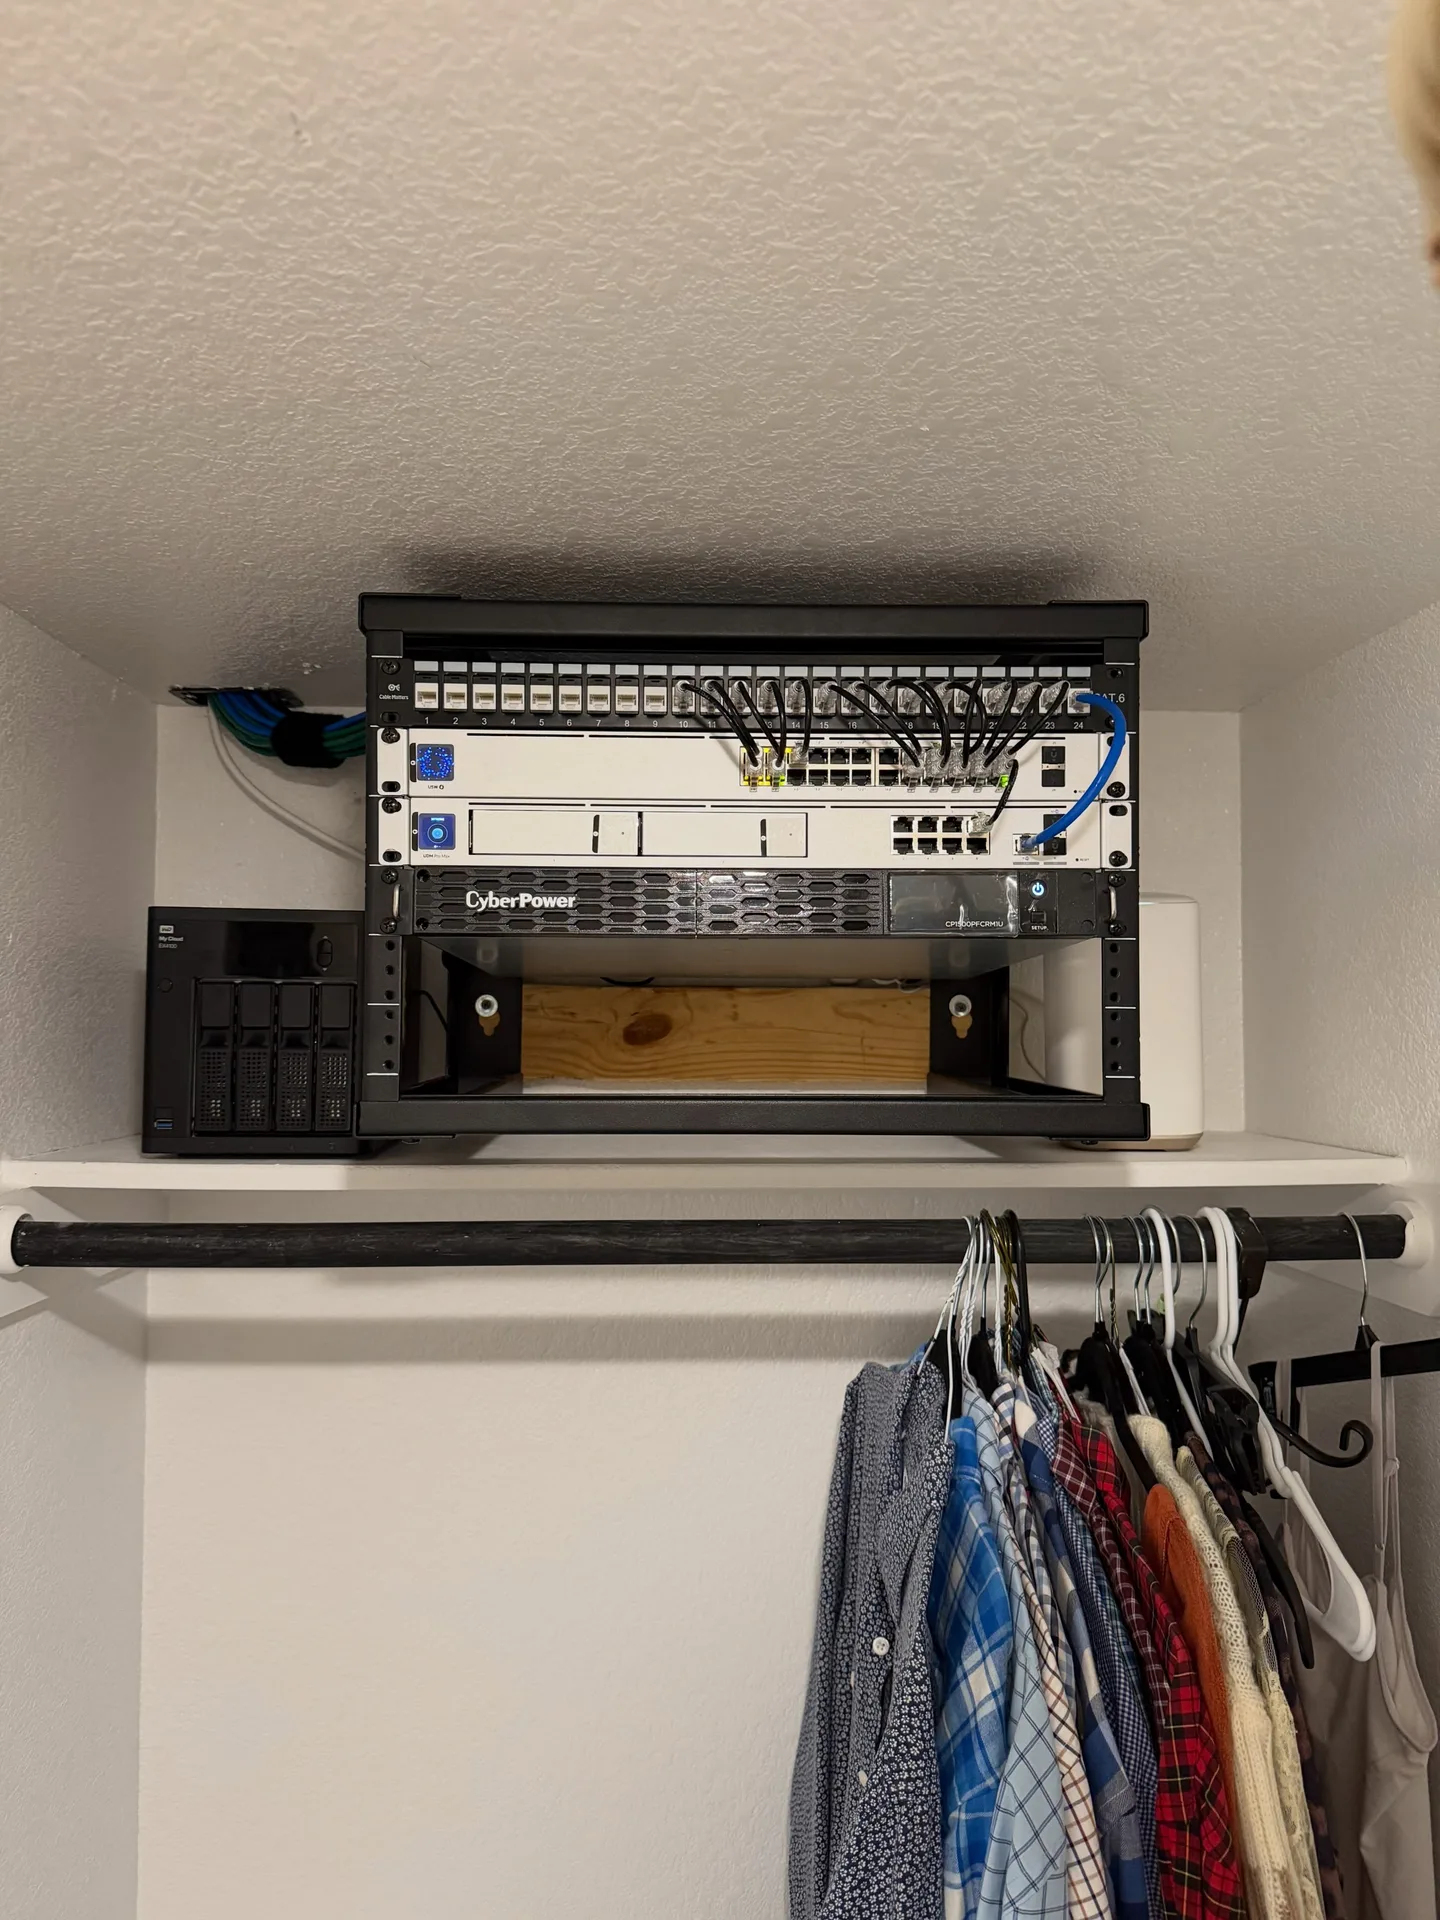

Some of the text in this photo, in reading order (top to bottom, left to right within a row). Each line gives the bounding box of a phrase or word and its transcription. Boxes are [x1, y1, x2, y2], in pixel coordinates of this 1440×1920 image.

[452, 717, 459, 725] 2
[481, 717, 488, 726] 3
[510, 718, 516, 726] 4
[539, 718, 545, 726] 5
[566, 719, 572, 727] 6
[596, 719, 602, 727] 7
[624, 720, 630, 728] 8
[652, 720, 658, 728] 9
[791, 721, 801, 729] 14
[820, 721, 829, 729] 15
[848, 721, 857, 729] 16
[1045, 721, 1055, 729] 23
[1073, 721, 1083, 729] 24
[466, 891, 576, 911] CyberPower
